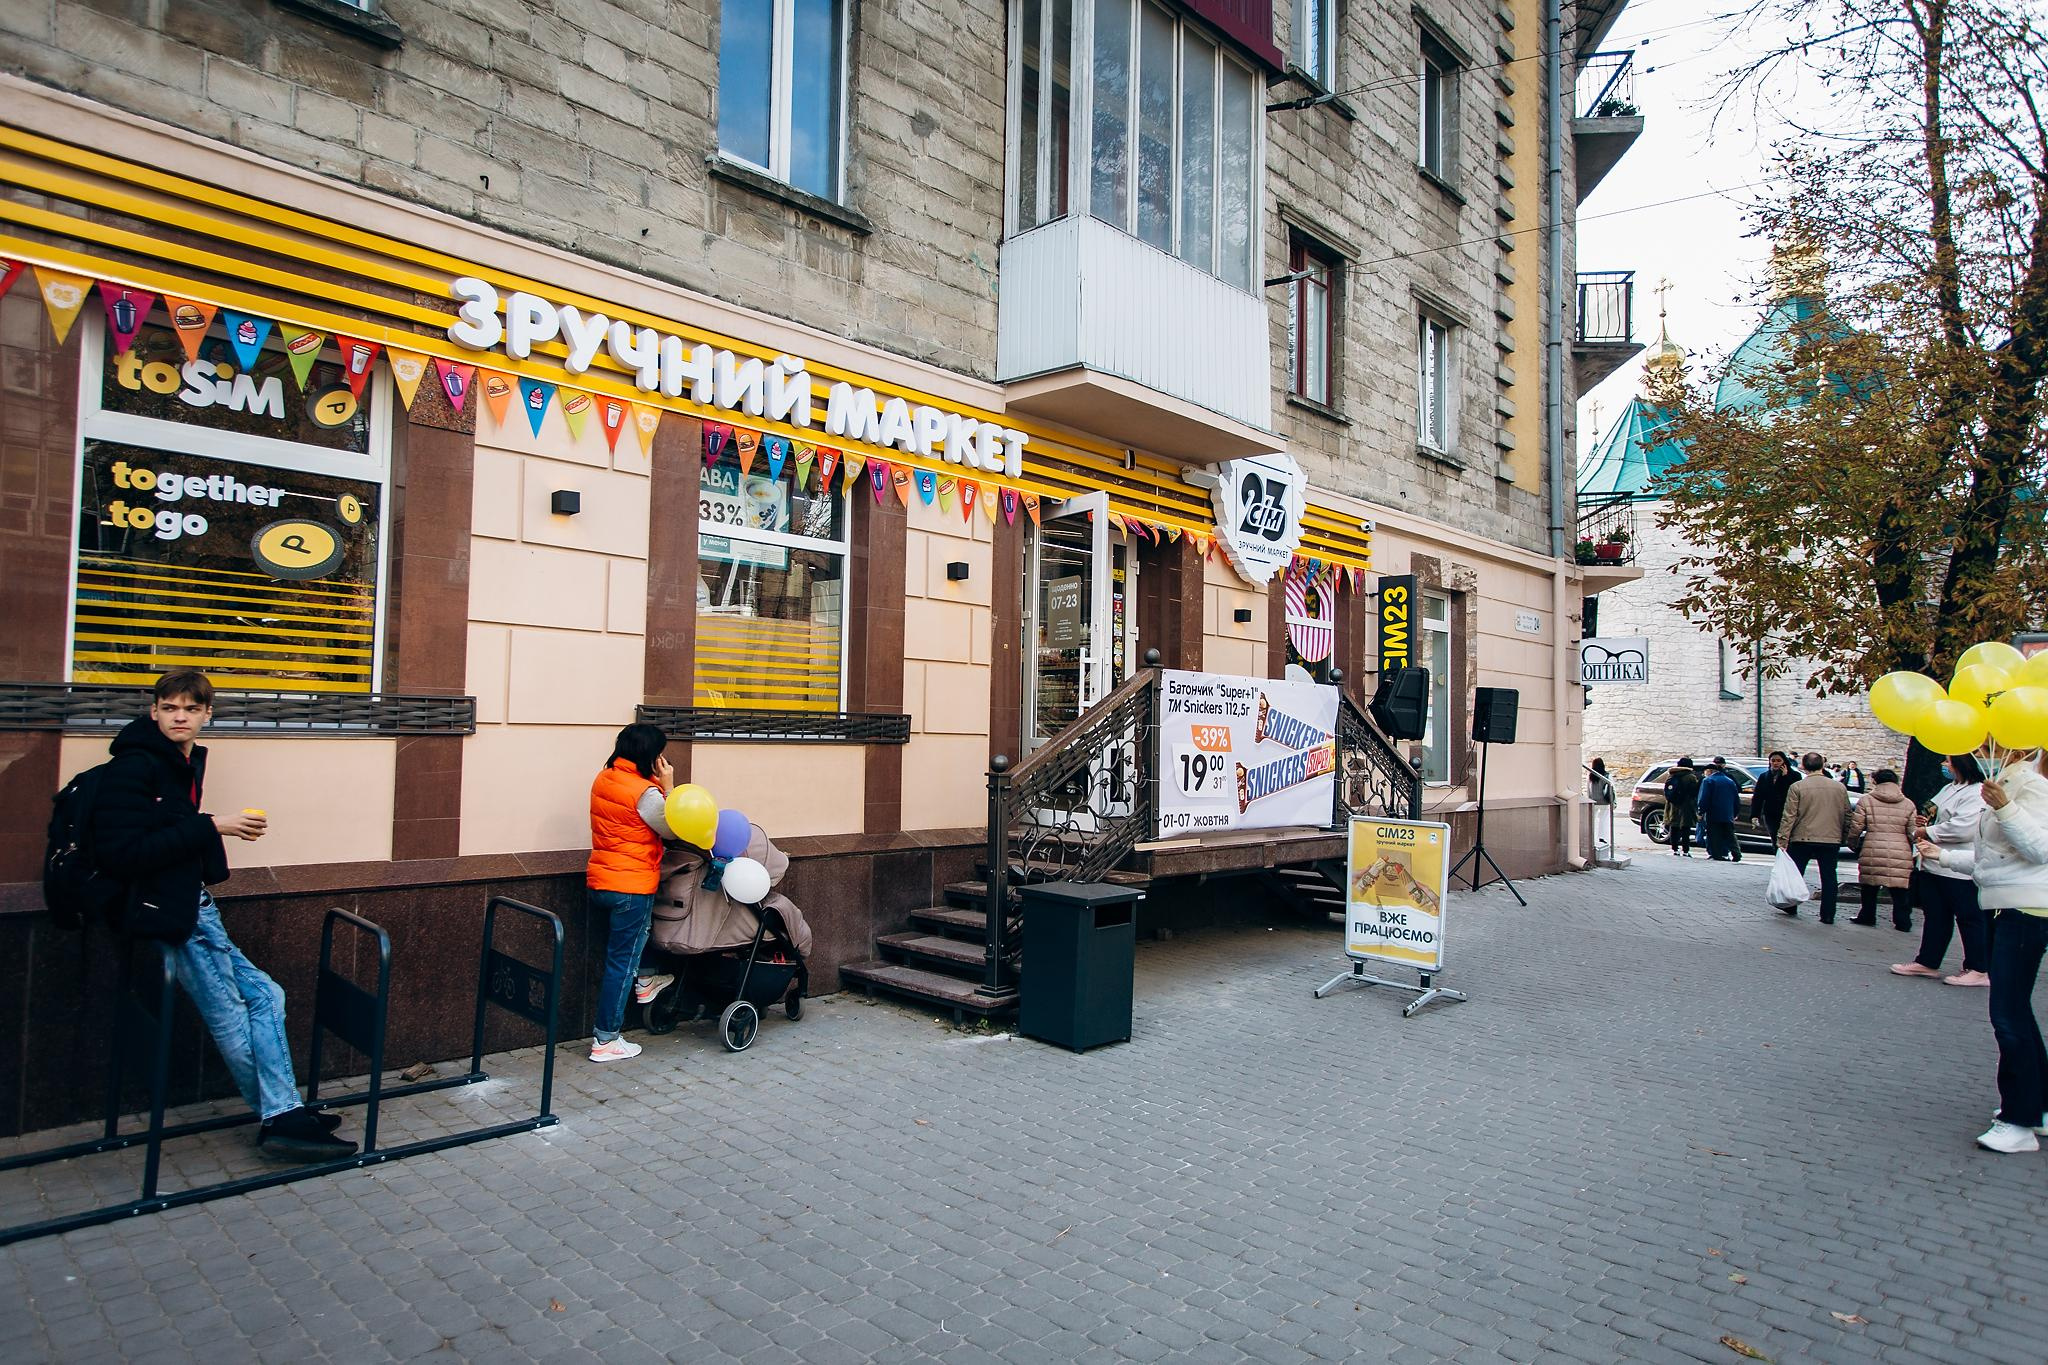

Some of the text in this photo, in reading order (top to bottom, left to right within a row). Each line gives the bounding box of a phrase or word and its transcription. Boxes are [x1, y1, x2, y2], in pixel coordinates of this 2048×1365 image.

[447, 276, 1030, 480] ЗРУЧНИЙ МАРКЕТ
[111, 461, 286, 508] together
[1240, 472, 1288, 542] 23
[109, 500, 209, 541] togo
[1238, 540, 1289, 559] ЗРУЧНИЙ МАРКЕТ
[1051, 594, 1078, 610] 07-23
[1583, 663, 1643, 681] ОПТИКА
[1169, 681, 1259, 701] Батончик "Super+1"
[1168, 698, 1250, 717] ТМ Snickers 112,5г
[1194, 727, 1229, 748] -39%
[1180, 753, 1224, 792] 19 00
[1247, 750, 1309, 801] SNICKERS
[1163, 813, 1190, 828] 01-07
[1376, 826, 1415, 840] СІМ23
[1379, 911, 1407, 925] ВЖЕ
[1354, 922, 1433, 944] ПРАЦЮЄМО
